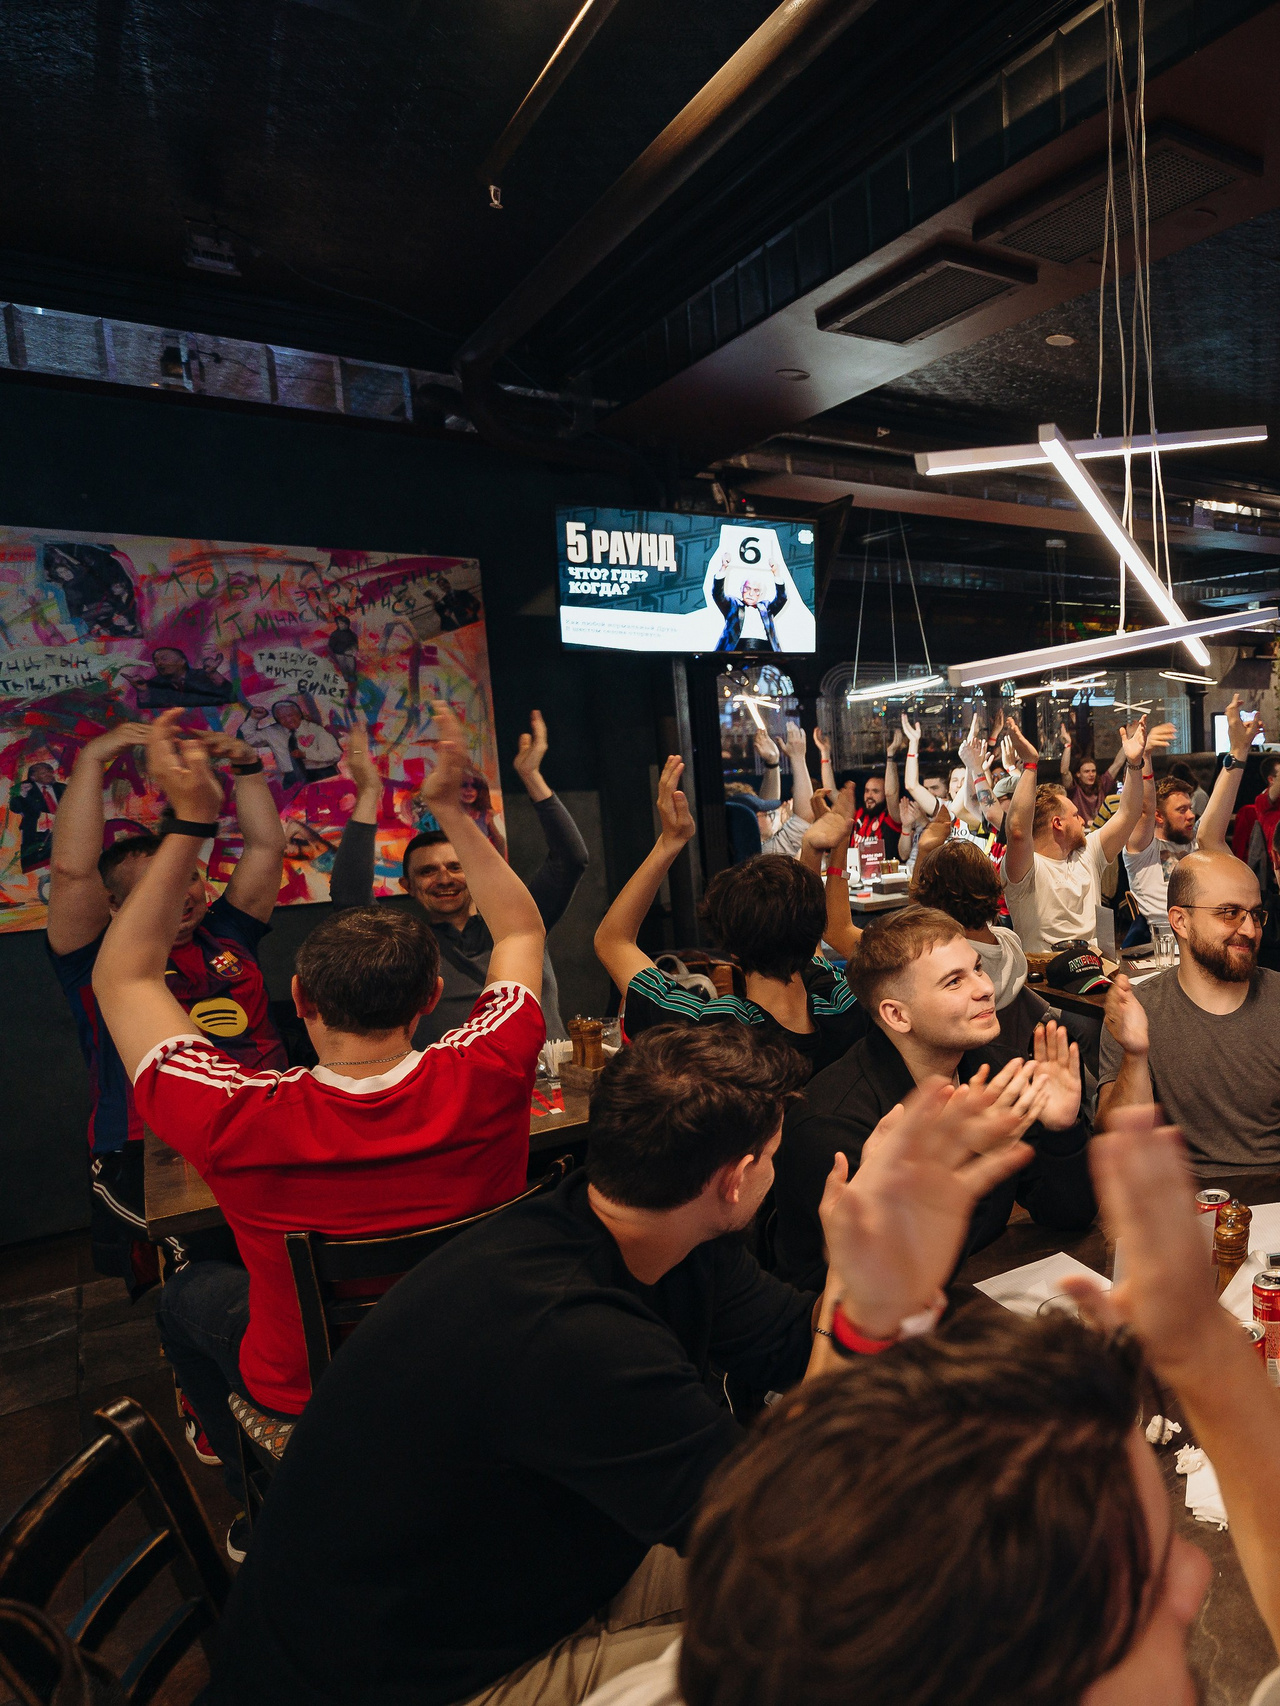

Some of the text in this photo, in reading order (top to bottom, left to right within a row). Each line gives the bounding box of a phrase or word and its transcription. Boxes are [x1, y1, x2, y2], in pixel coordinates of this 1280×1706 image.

[566, 521, 677, 572] 5 РАУНД
[739, 536, 762, 565] 6
[164, 571, 281, 602] ЛОВИ
[567, 566, 649, 584] ЧТО? ГДЕ?
[568, 581, 631, 598] КОГДА?
